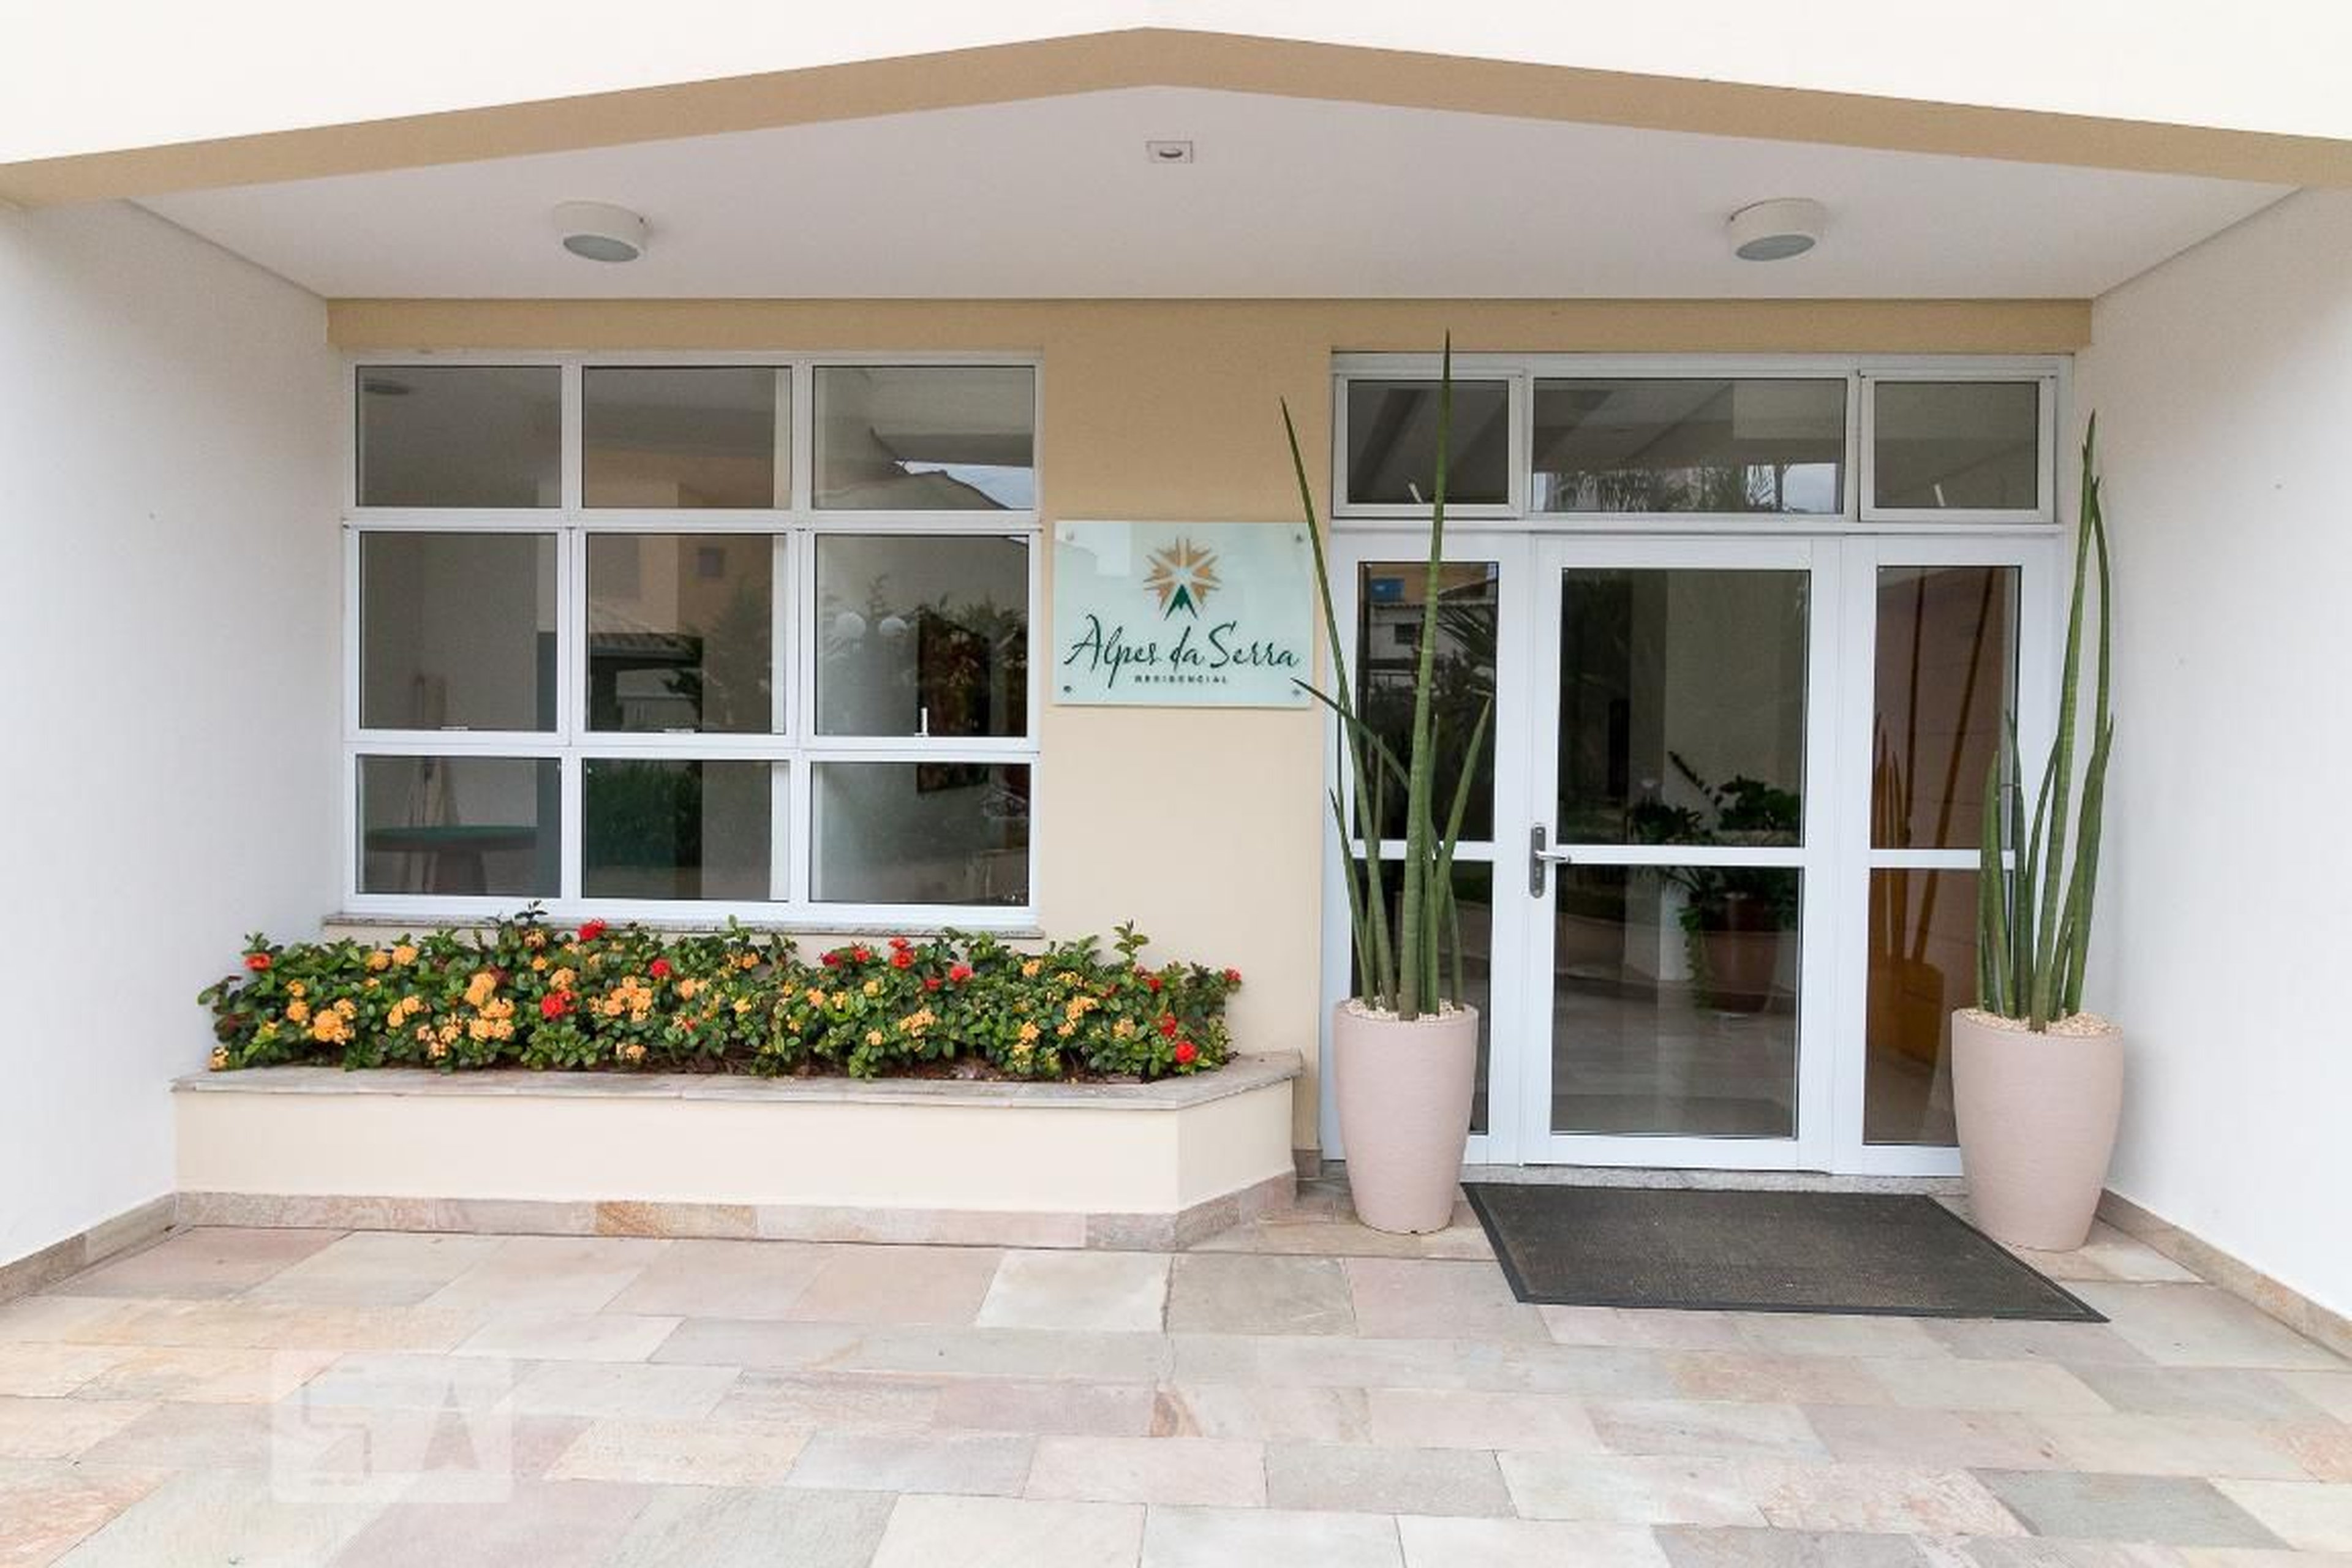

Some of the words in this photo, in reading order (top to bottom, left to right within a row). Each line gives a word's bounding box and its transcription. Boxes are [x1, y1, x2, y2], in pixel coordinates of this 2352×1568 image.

[1063, 614, 1160, 689] Alpes
[1169, 626, 1205, 671] da
[1208, 620, 1299, 669] Serra
[1134, 675, 1227, 684] RESIDENCIAL
